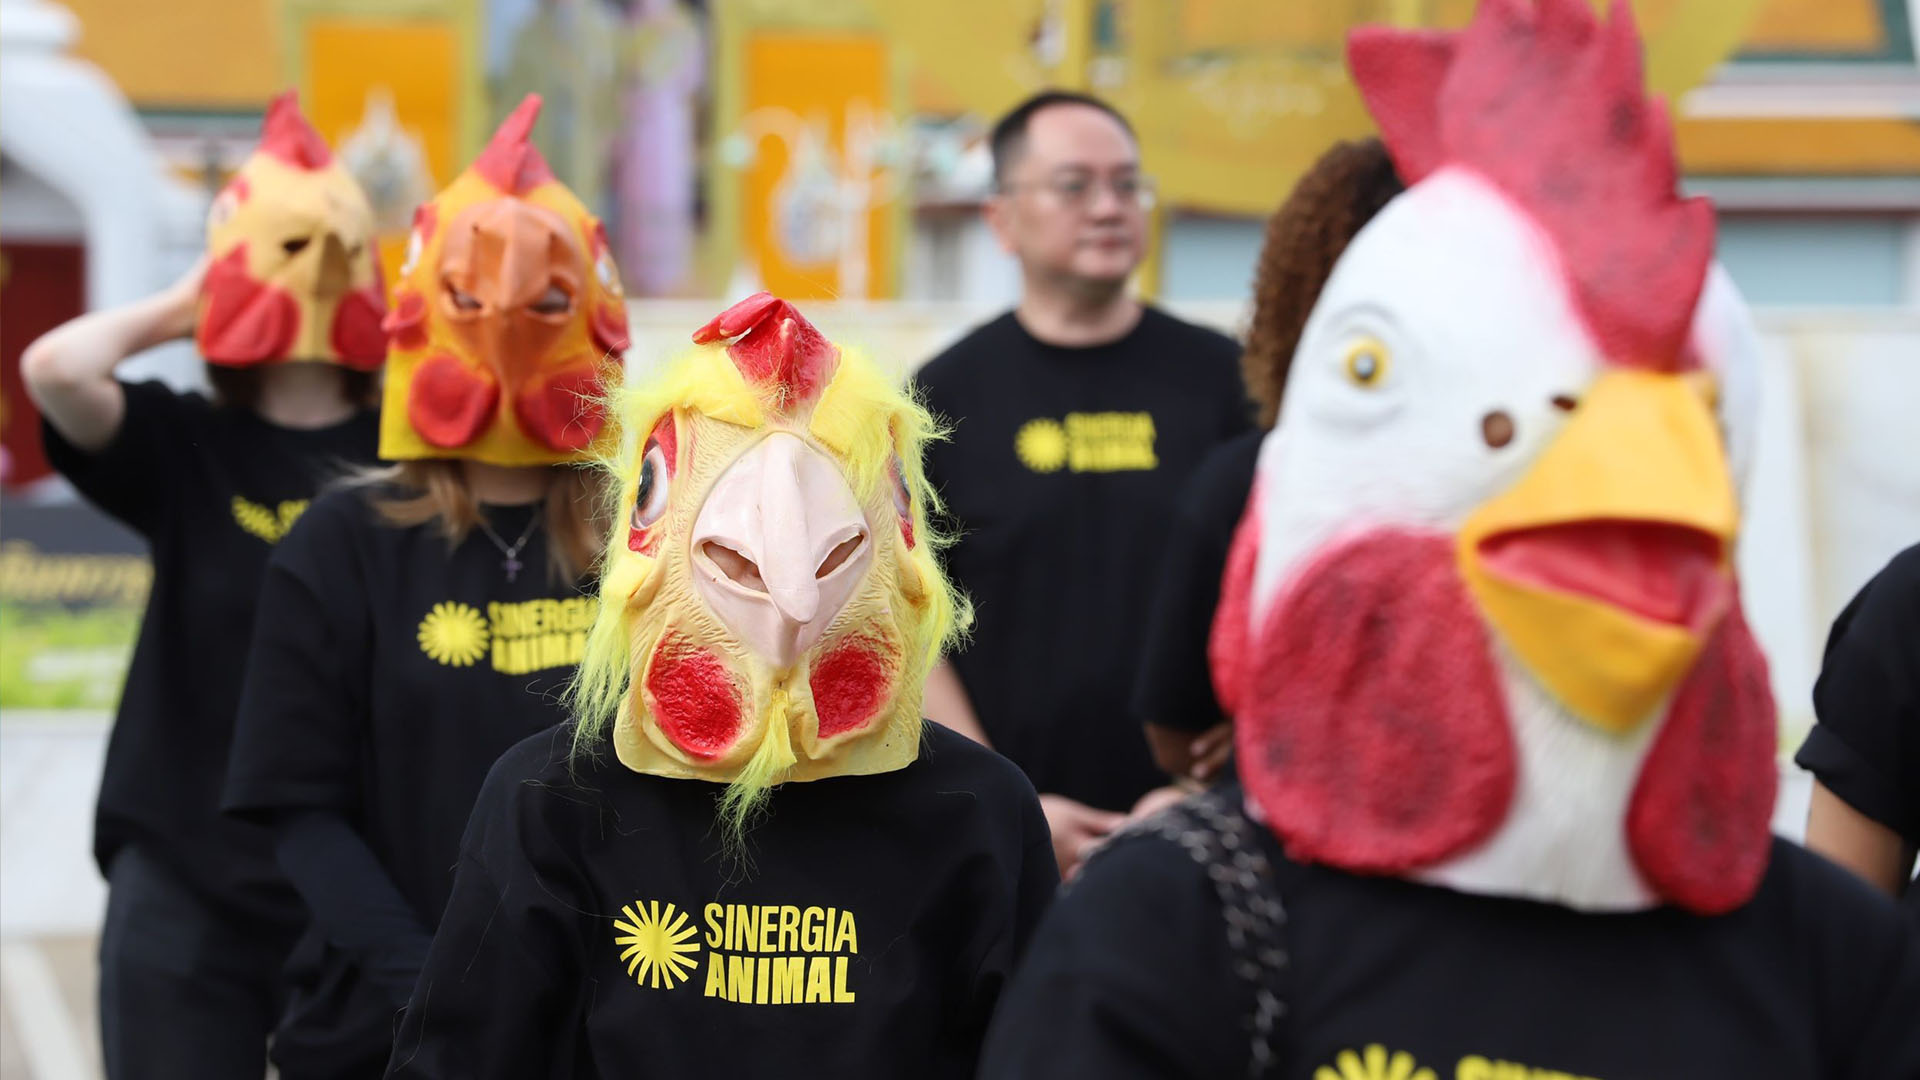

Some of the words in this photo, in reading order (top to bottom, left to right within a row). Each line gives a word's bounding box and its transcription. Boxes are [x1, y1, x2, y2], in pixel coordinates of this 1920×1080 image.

[491, 632, 589, 674] ANIMA
[704, 902, 858, 954] SINERGIA
[704, 951, 855, 1005] ANIMAL
